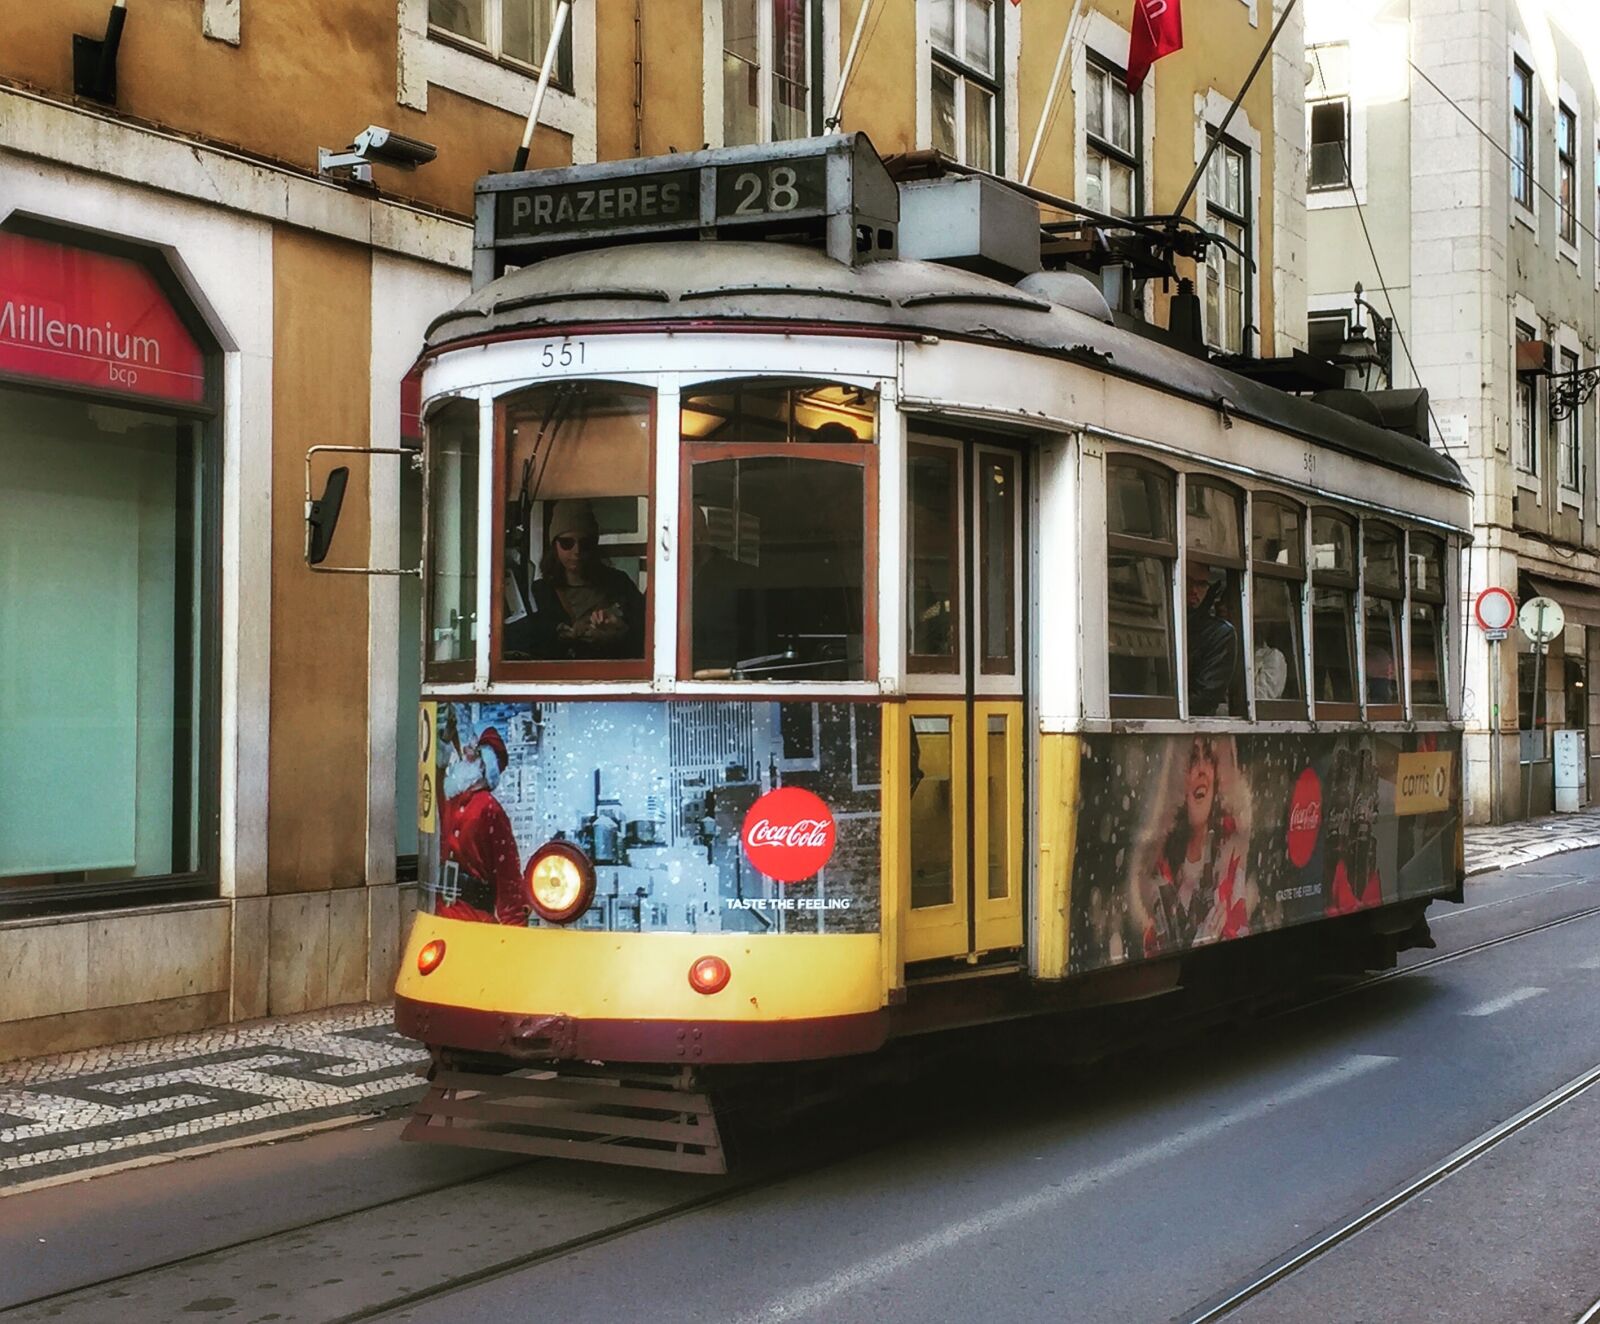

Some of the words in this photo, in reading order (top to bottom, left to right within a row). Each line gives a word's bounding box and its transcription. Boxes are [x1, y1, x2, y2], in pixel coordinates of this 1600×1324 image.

[734, 166, 800, 215] 28
[512, 183, 681, 226] PRAZERES
[542, 341, 585, 368] 551
[109, 361, 138, 388] bcp
[1303, 452, 1316, 472] 551
[747, 819, 832, 847] Coca-Cola
[725, 898, 767, 910] TASTE
[768, 898, 796, 910] THE
[797, 898, 851, 910] FEELING
